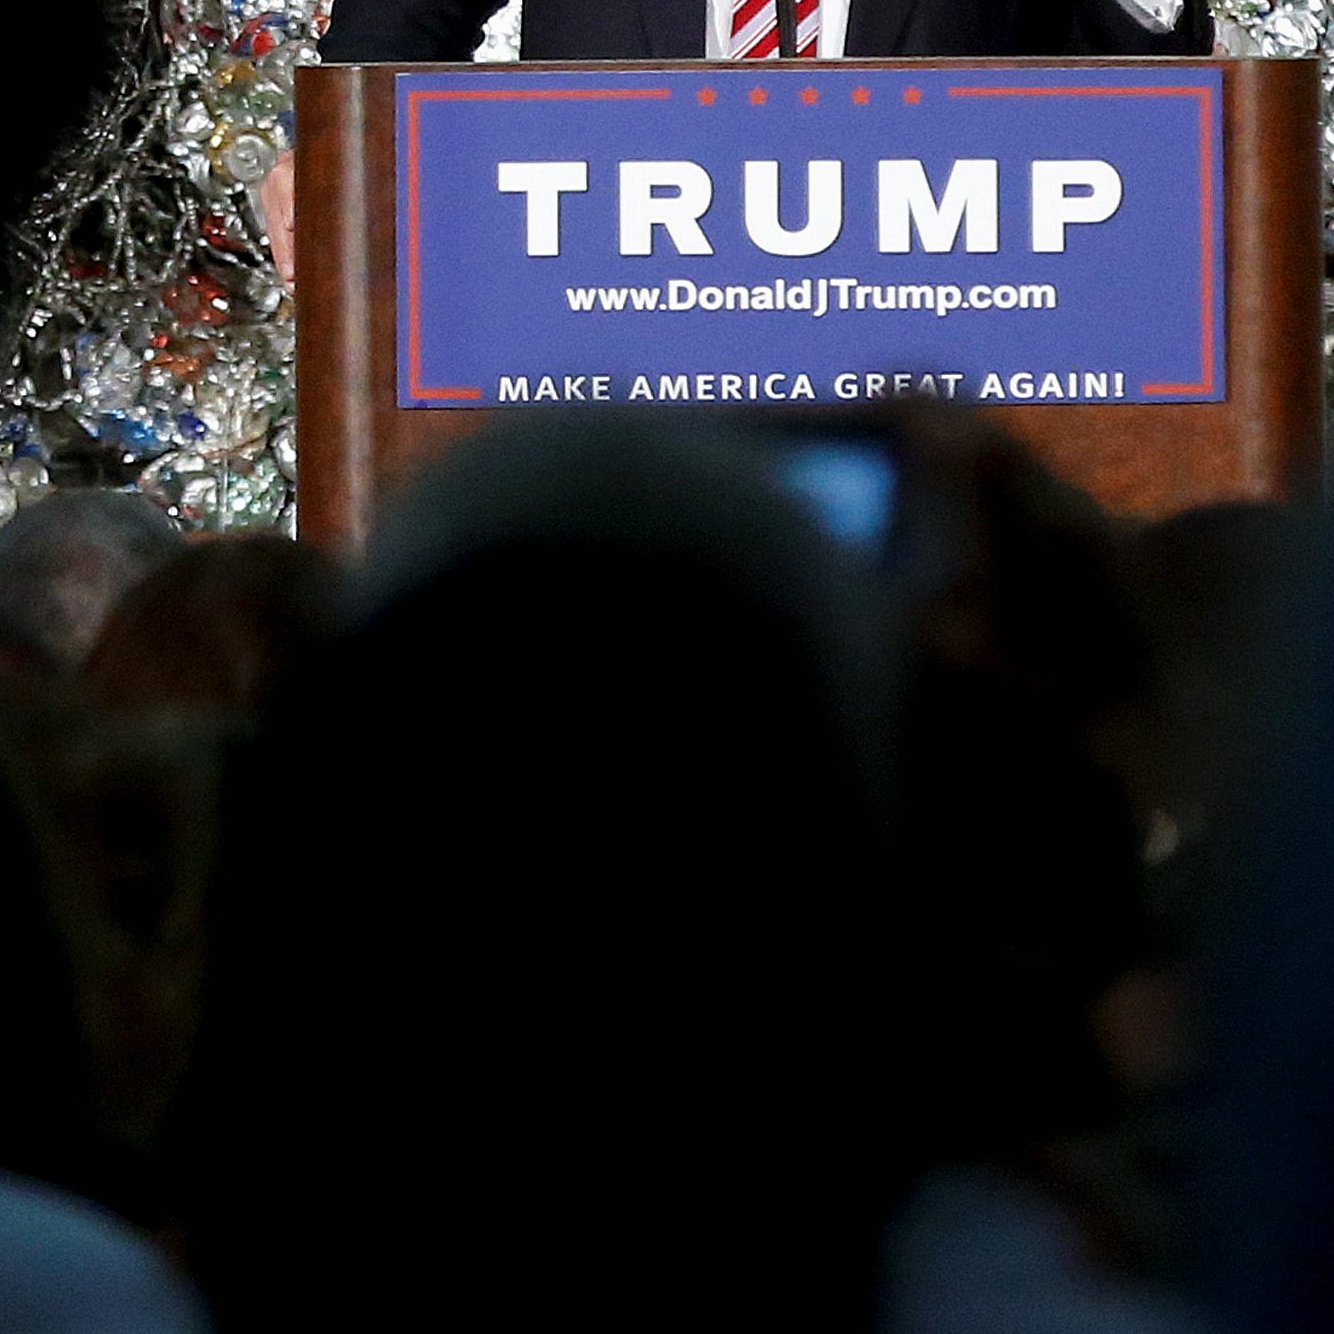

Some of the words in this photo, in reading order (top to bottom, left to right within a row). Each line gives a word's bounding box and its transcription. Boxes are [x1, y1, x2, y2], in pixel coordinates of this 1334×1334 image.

[496, 158, 1125, 257] TRUMP
[565, 277, 1058, 316] www.DonaldJTrump.com
[497, 375, 611, 402] MAKE
[628, 373, 816, 400] AMERICA
[833, 372, 964, 399] GREAT
[979, 371, 1125, 398] AGAIN!
